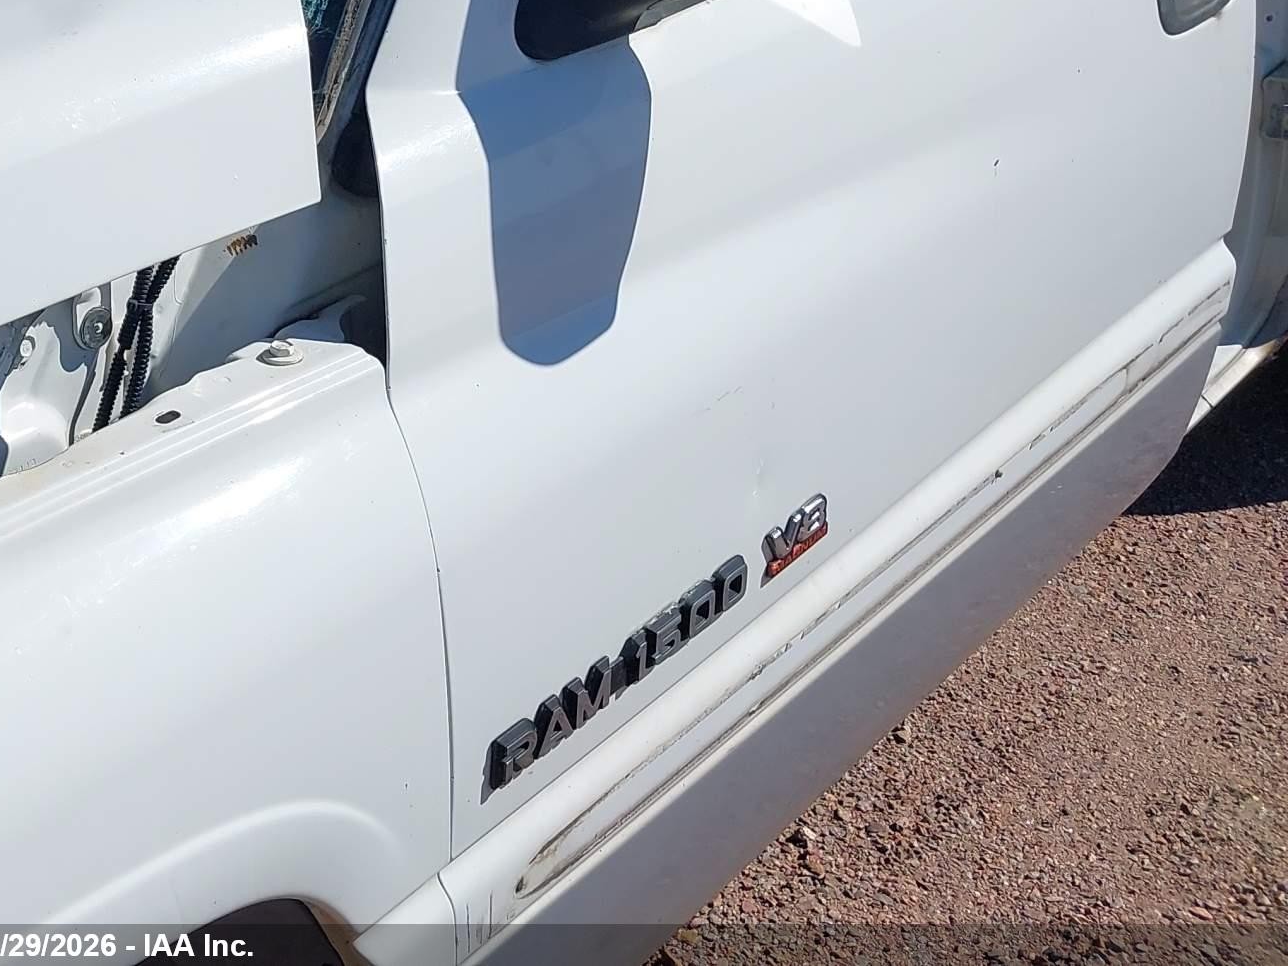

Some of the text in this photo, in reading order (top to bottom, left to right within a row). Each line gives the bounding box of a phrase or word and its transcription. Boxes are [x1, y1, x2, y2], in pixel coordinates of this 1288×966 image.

[761, 493, 828, 562] V8
[489, 554, 749, 789] RAM 1500
